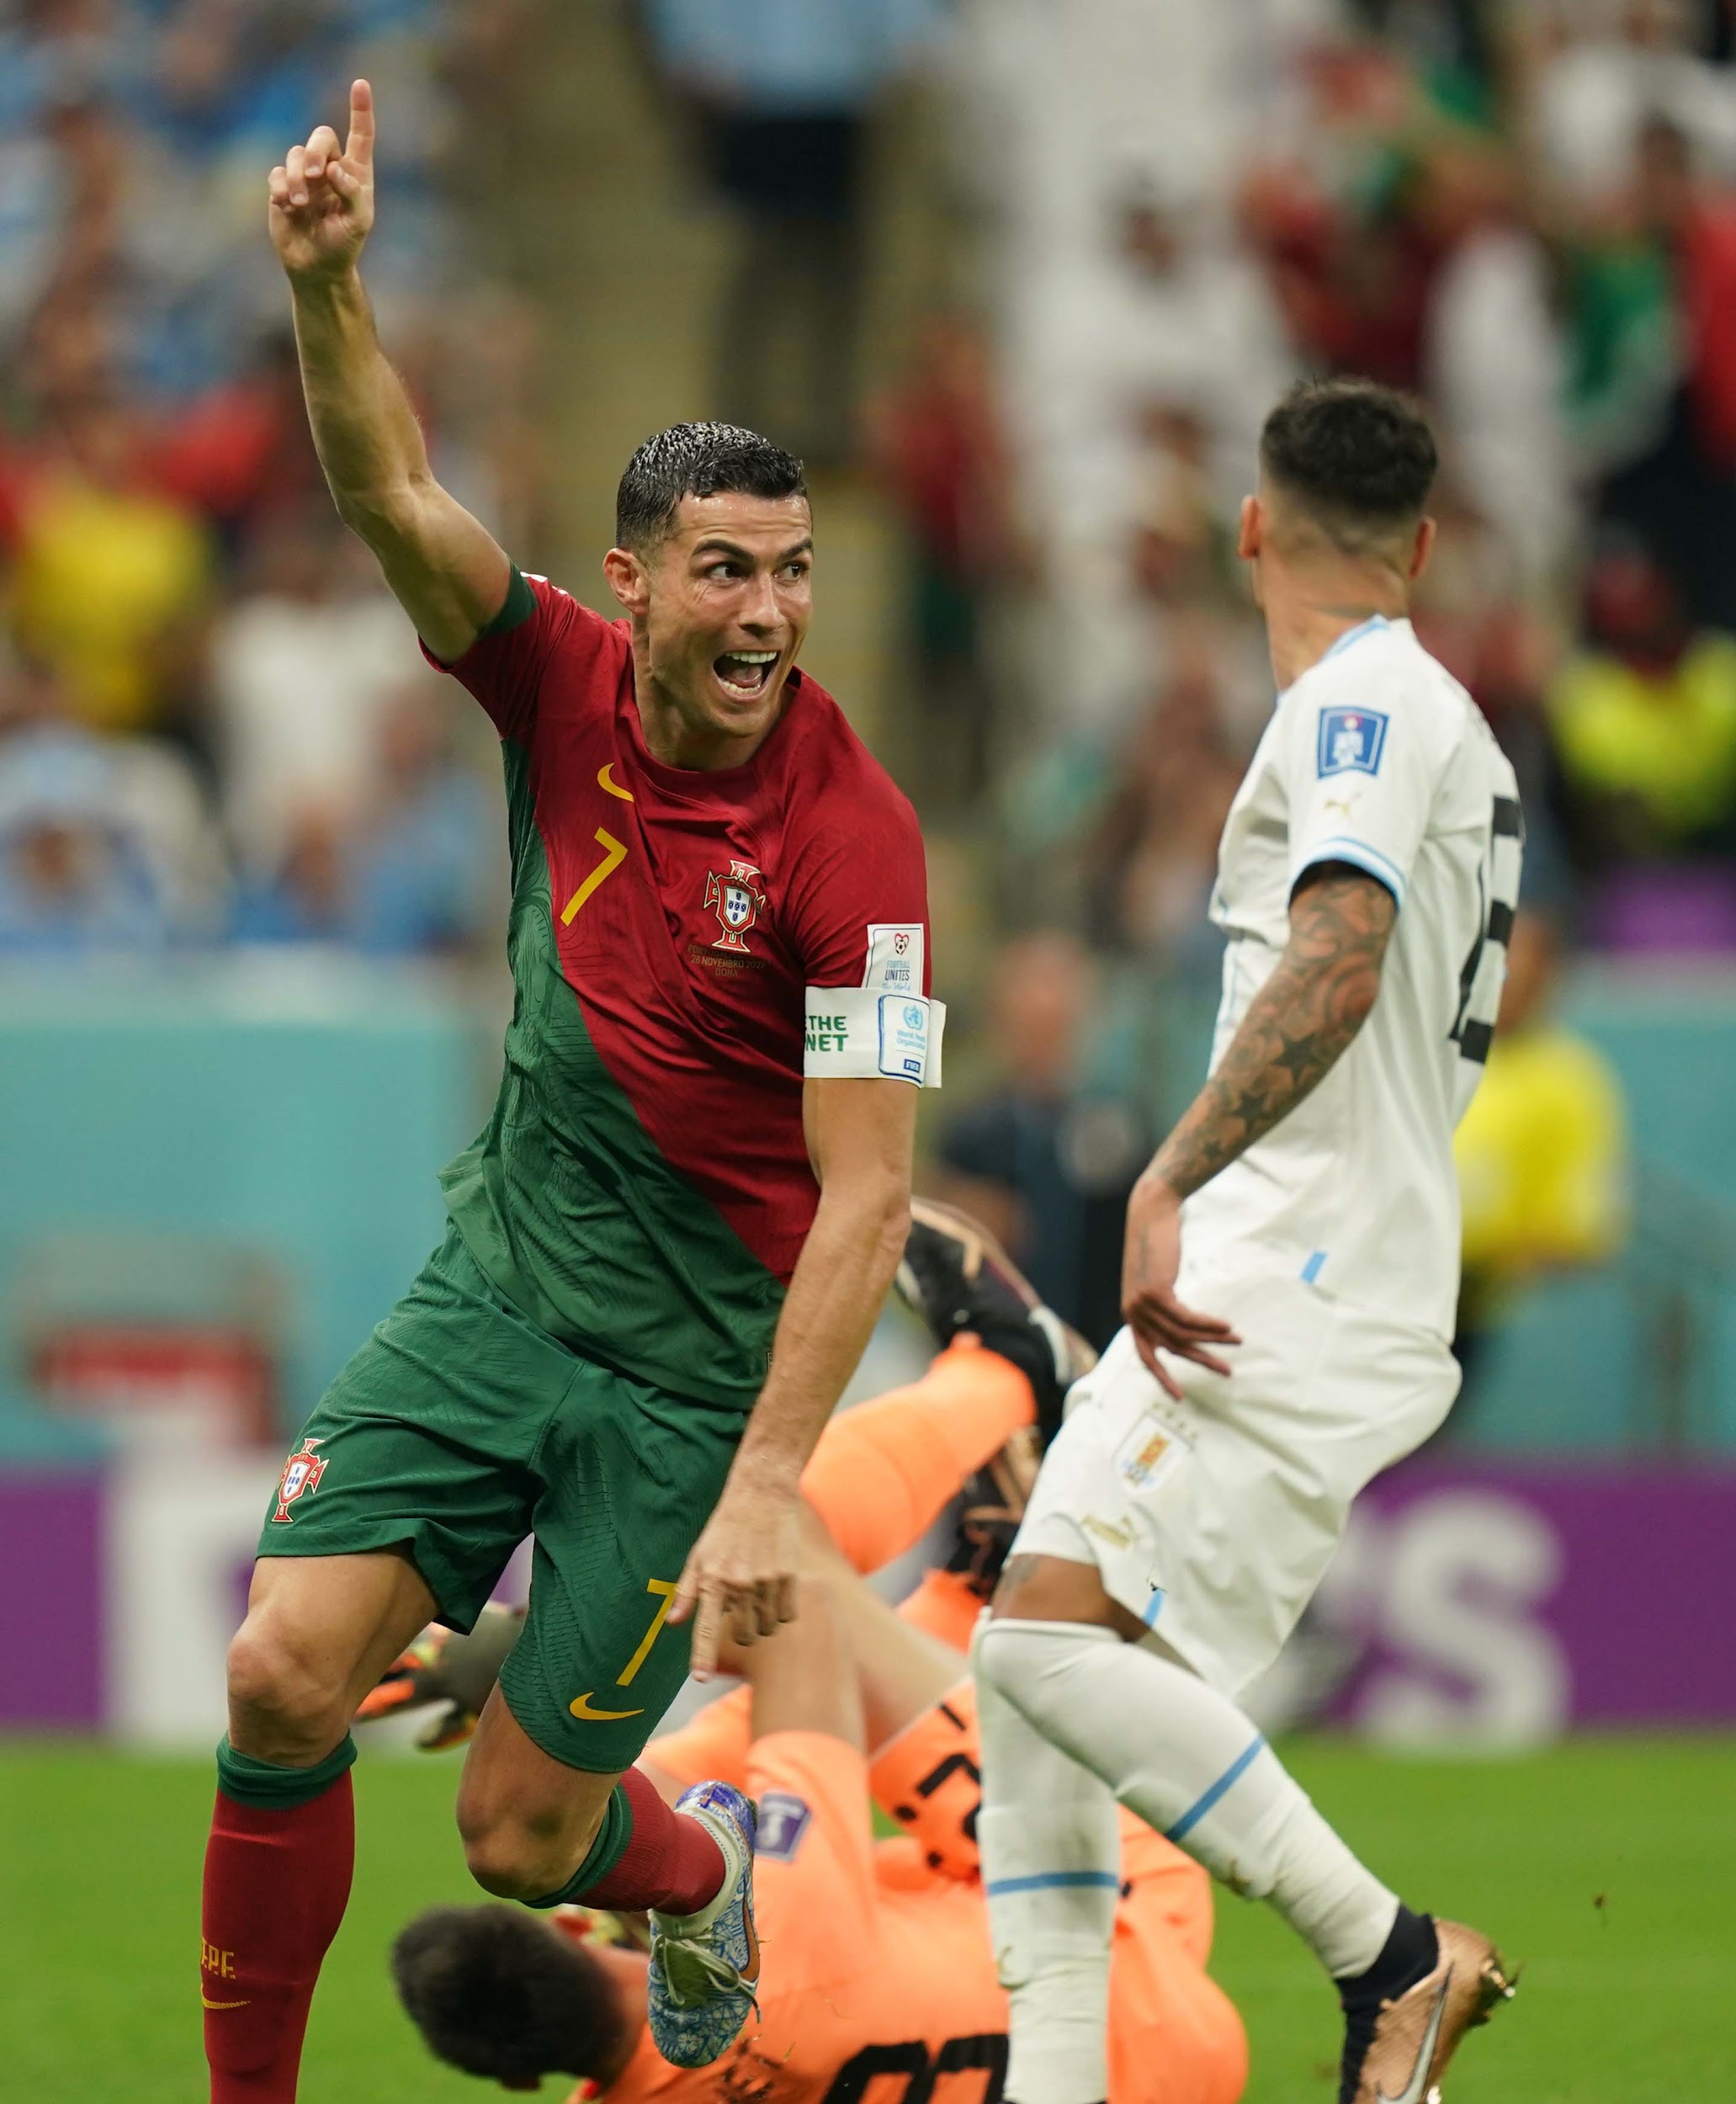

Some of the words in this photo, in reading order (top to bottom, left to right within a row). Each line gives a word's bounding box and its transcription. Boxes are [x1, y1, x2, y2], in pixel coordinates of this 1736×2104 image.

[559, 826, 629, 927] 7
[702, 958, 744, 969] NOVEMBRO
[715, 968, 738, 977] DOHA
[884, 969, 910, 981] UNITES
[808, 1015, 847, 1031] THE
[615, 1577, 680, 1687] 7
